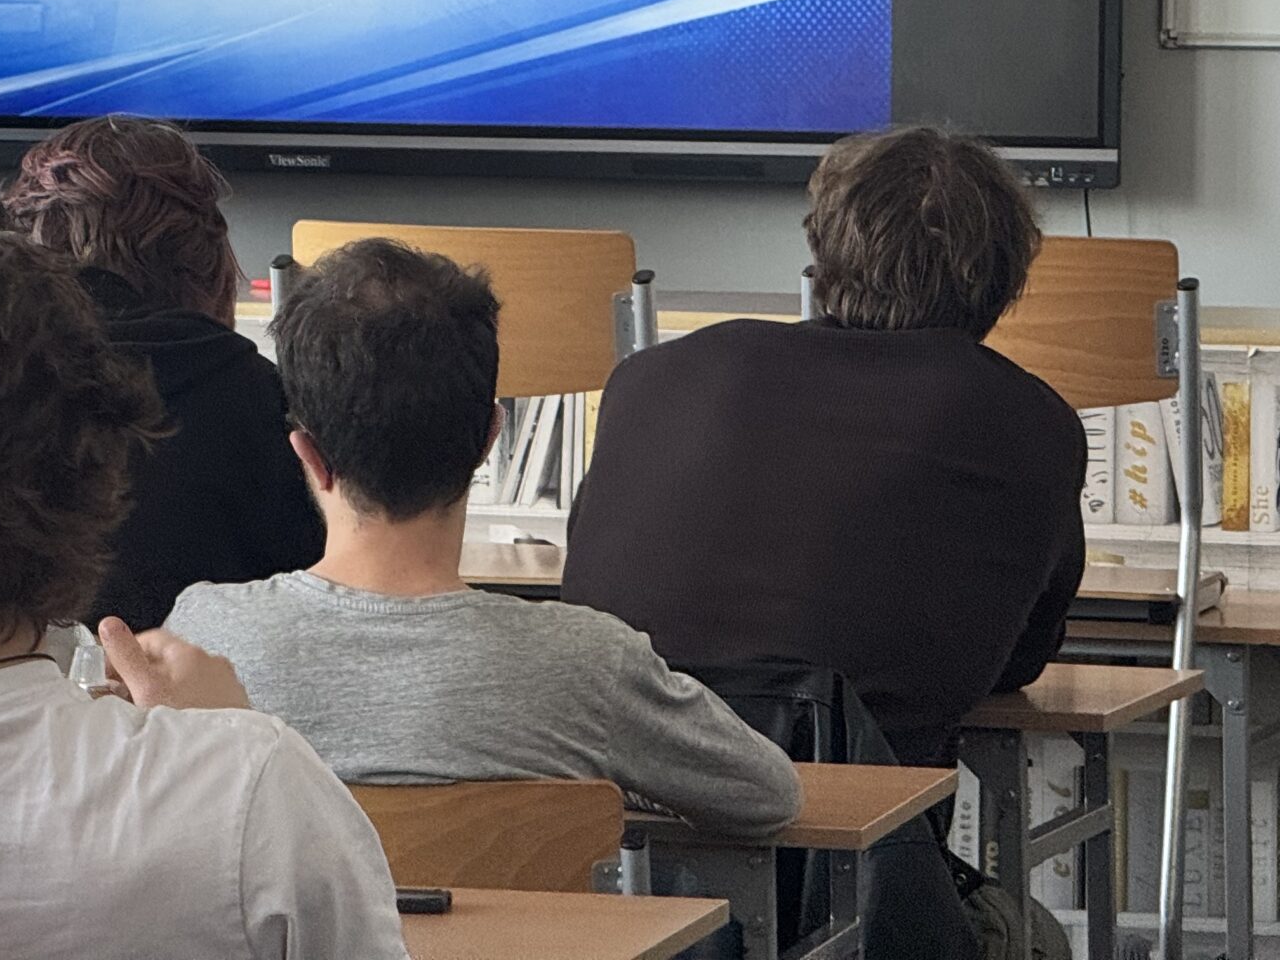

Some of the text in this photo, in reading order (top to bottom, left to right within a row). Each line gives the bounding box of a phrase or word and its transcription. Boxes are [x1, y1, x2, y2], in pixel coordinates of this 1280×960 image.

[268, 153, 331, 168] ViewSonic
[1124, 420, 1157, 510] #hip
[1251, 484, 1270, 525] She
